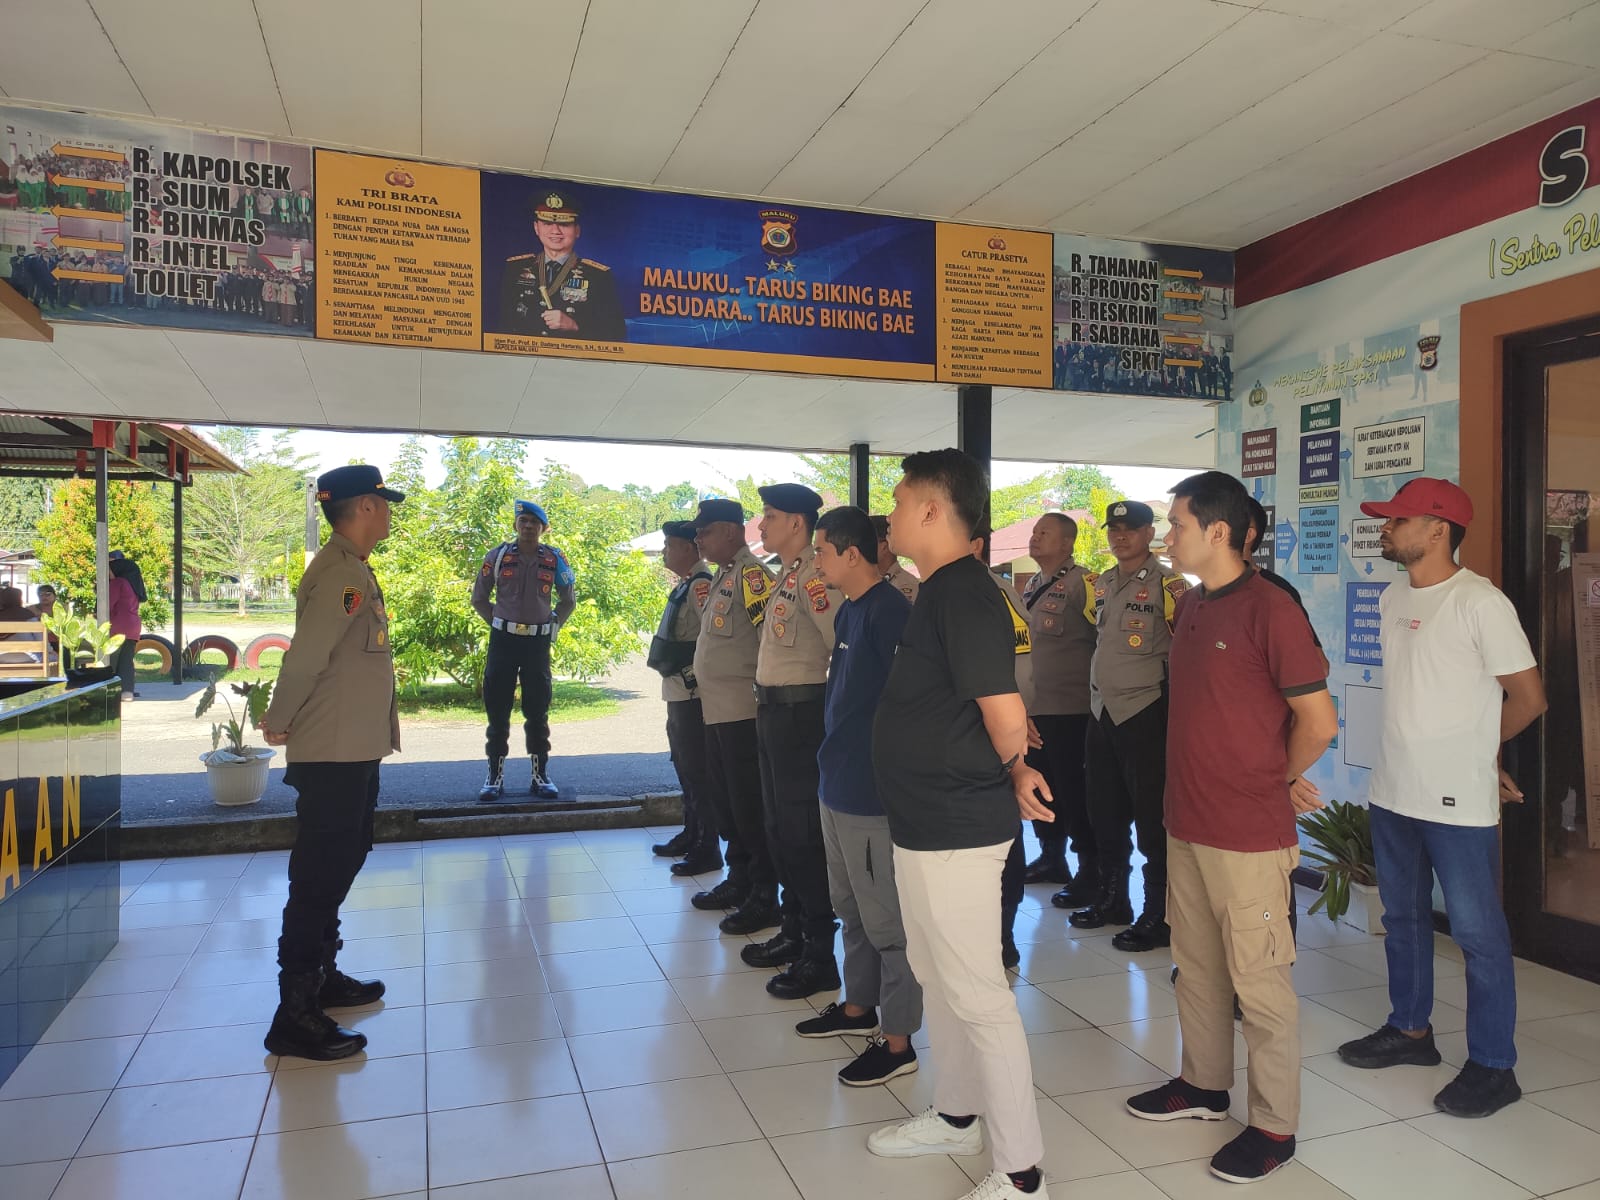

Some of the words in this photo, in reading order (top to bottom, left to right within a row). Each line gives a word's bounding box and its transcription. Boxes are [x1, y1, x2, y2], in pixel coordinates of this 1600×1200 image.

[132, 146, 157, 174] R.
[162, 151, 292, 192] KAPOLSEK
[1539, 126, 1589, 207] S
[132, 176, 157, 204] R.
[162, 180, 230, 213] SIUM
[361, 188, 385, 199] TRI
[391, 191, 438, 205] BRATA
[336, 198, 365, 208] KAMI
[368, 201, 401, 212] POLISI
[405, 205, 461, 219] INDONESIA
[761, 211, 796, 220] MALUKU
[132, 207, 157, 235] R.
[162, 210, 265, 246] BINMAS
[132, 237, 156, 264] R.
[162, 242, 232, 272] INTEL
[962, 250, 987, 259] CATUR
[990, 253, 1028, 263] PRASETYA
[1071, 253, 1086, 274] R.
[1089, 255, 1158, 281] TAHANAN
[132, 268, 218, 300] TOILET
[643, 267, 741, 295] MALUKU..
[745, 277, 807, 300] TARUS
[811, 283, 874, 306] BIKING
[878, 289, 912, 309] BAE
[1071, 276, 1086, 296] R.
[1089, 277, 1159, 303] PROVOST
[640, 294, 753, 321] BASUDARA..
[757, 302, 815, 326] TARUS
[819, 308, 877, 331] BIKING
[881, 314, 915, 334] BAE
[1071, 299, 1086, 320] R.
[1089, 301, 1157, 326] RESKRIM
[1071, 322, 1086, 342] R.
[1089, 323, 1161, 348] SABRAHA
[1121, 350, 1161, 371] SPKT
[1273, 364, 1328, 388] MEKANISME
[1126, 603, 1154, 613] POLRI
